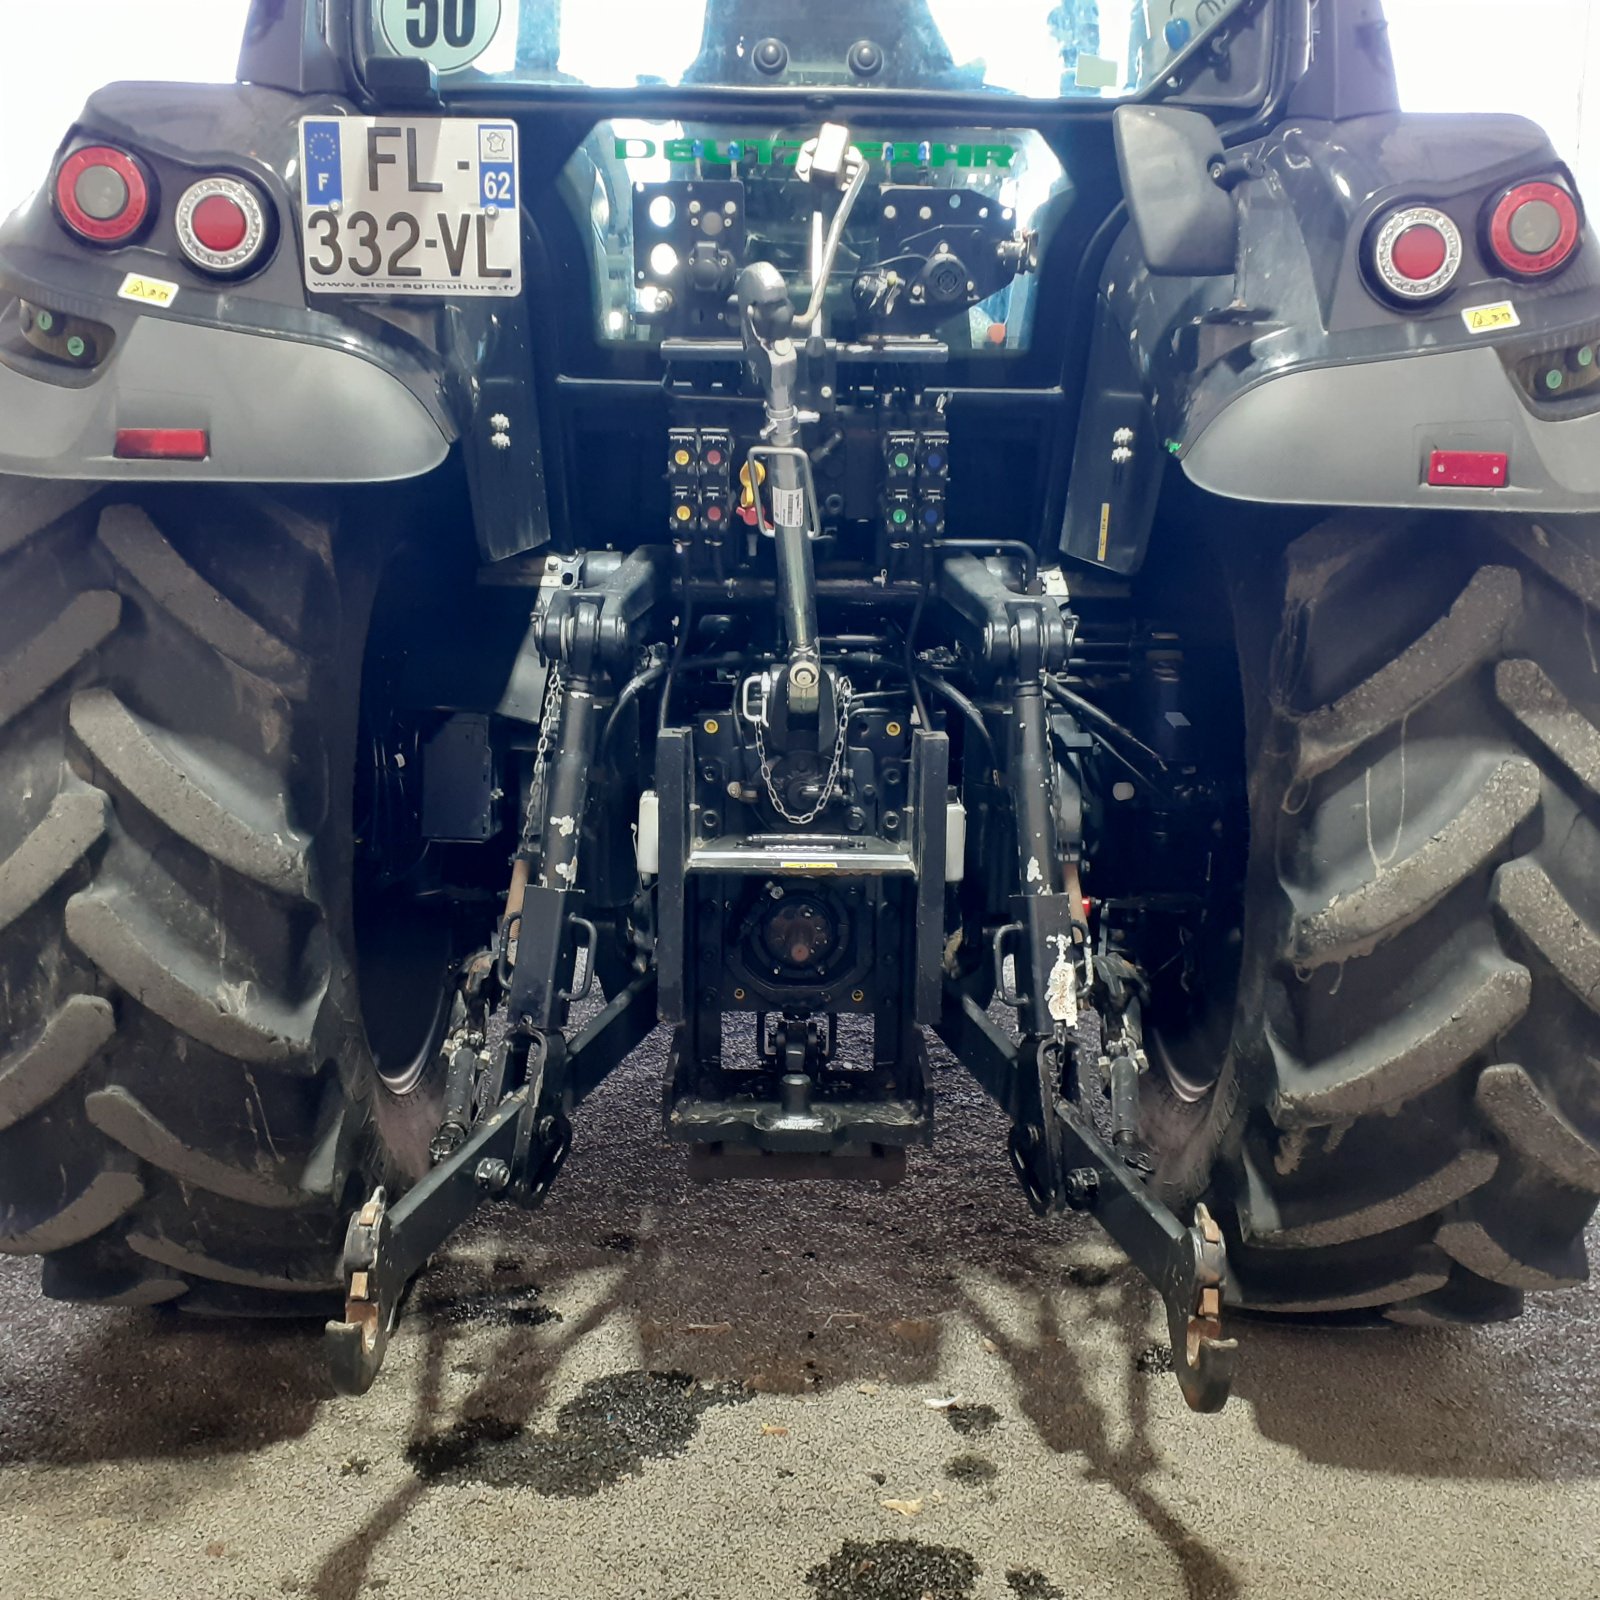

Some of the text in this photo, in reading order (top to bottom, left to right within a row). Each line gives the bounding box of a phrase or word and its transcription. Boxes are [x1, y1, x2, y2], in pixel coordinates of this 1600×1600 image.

[406, 0, 476, 48] 50
[318, 173, 330, 192] F
[484, 172, 510, 200] 62
[308, 211, 512, 278] 332-VL
[312, 280, 516, 292] www.sica-agriculture.fr
